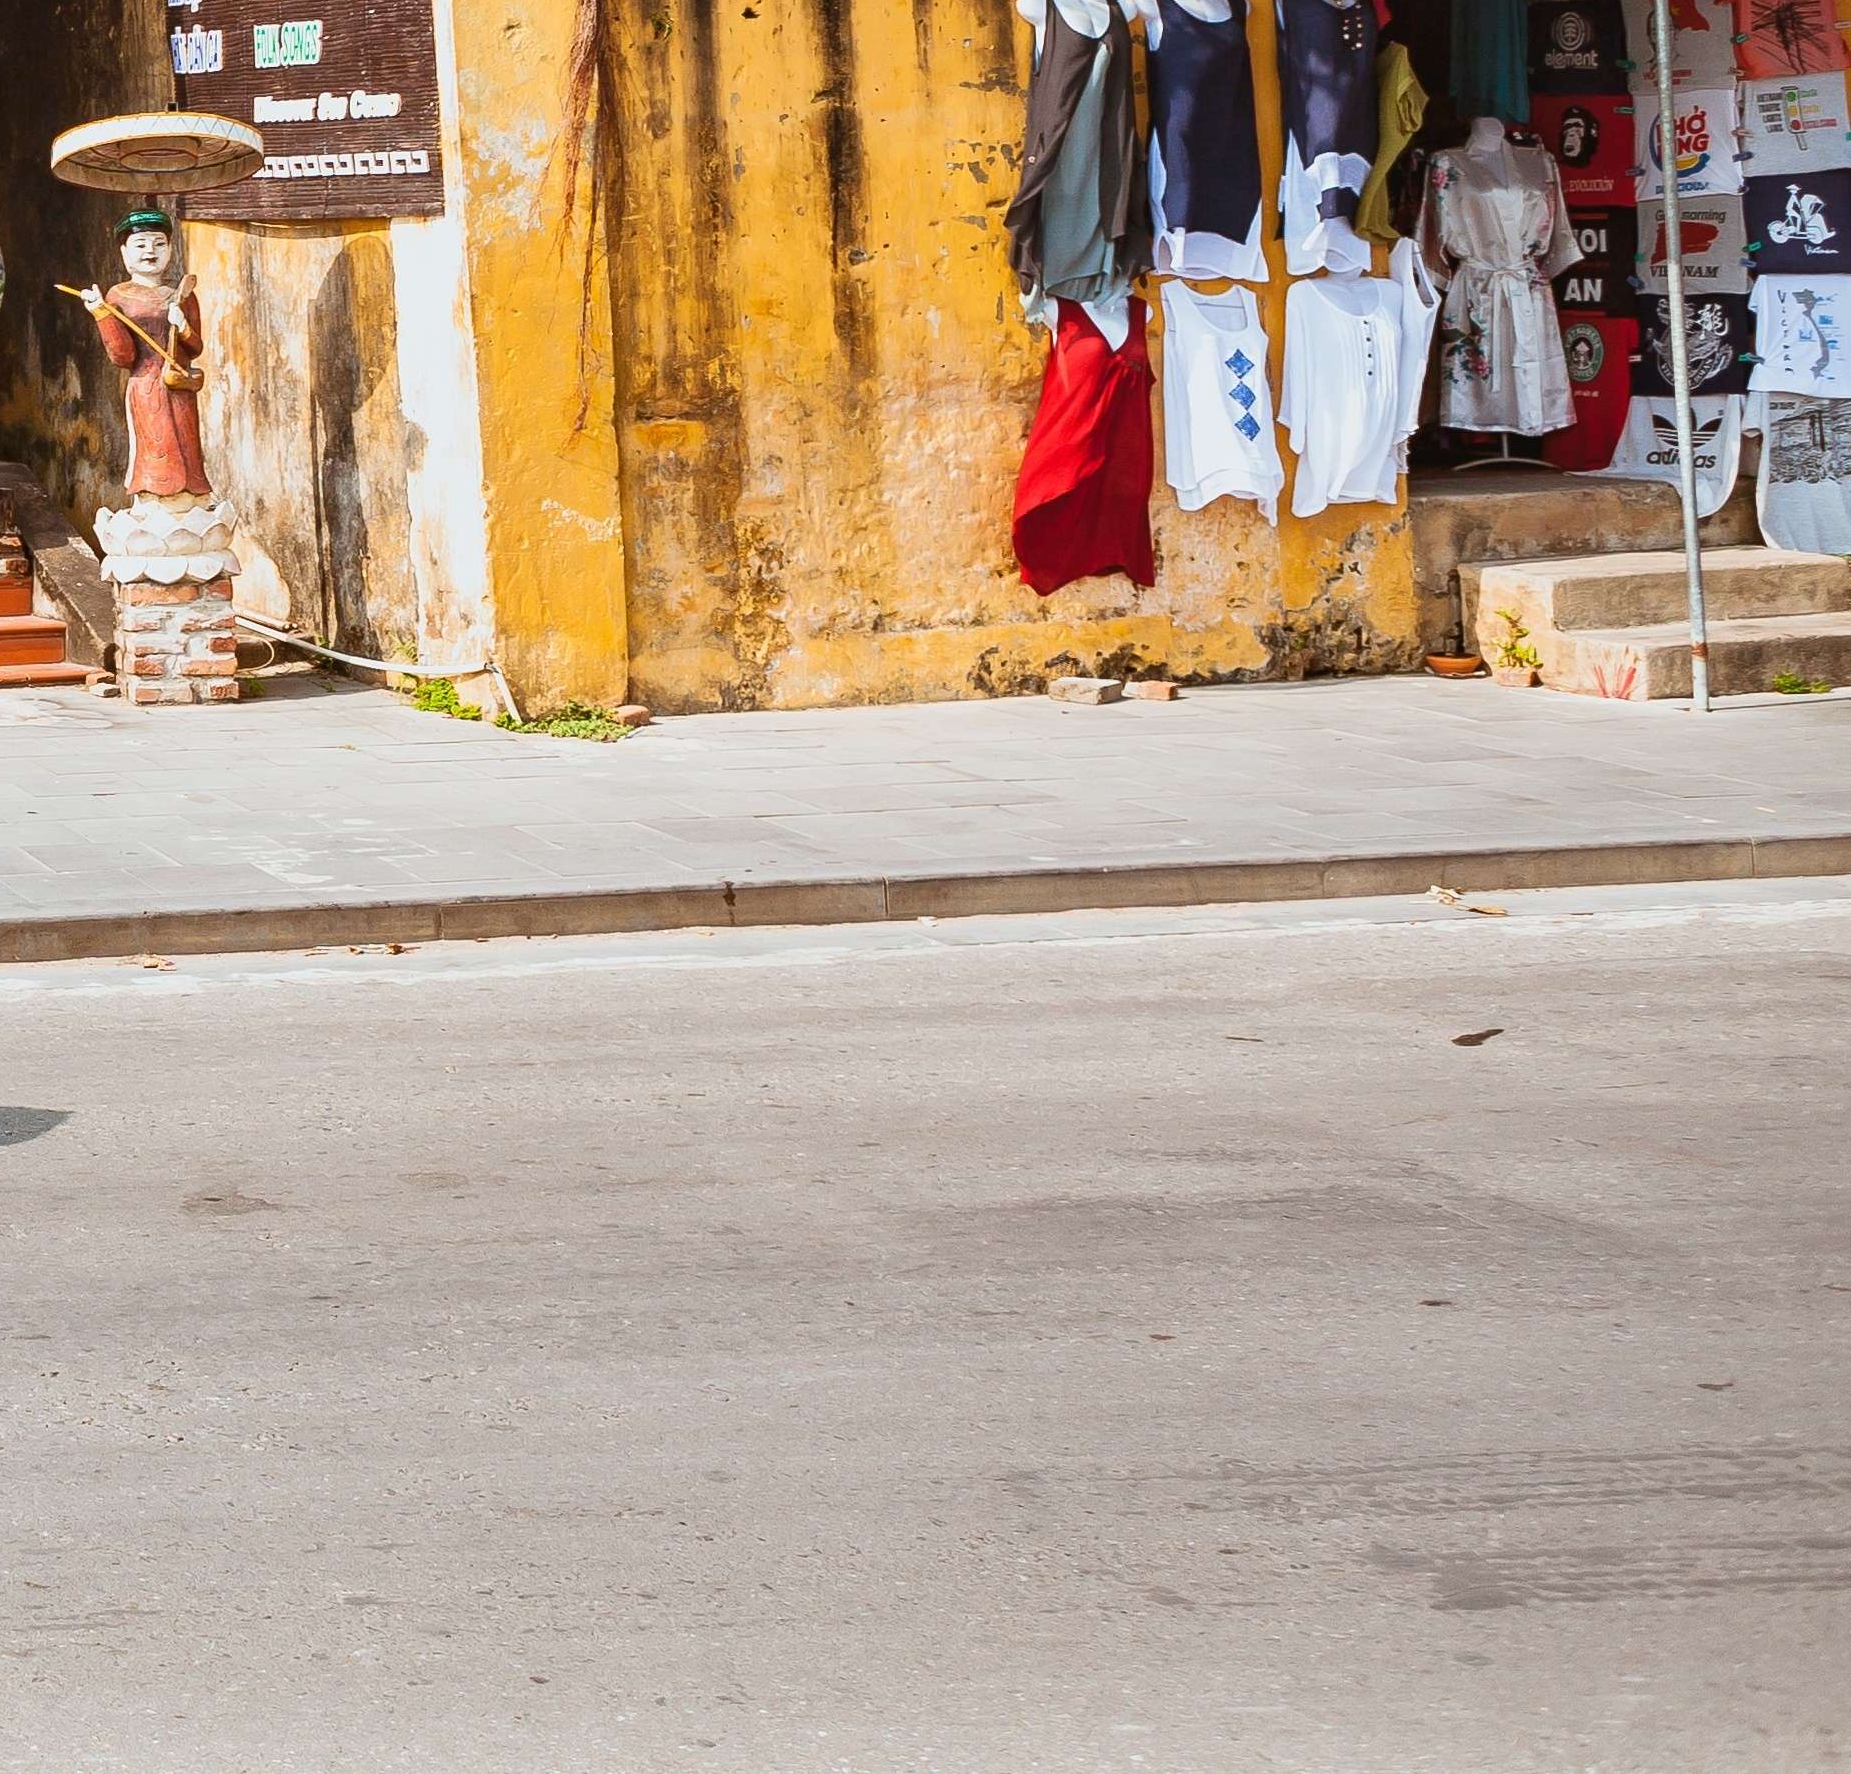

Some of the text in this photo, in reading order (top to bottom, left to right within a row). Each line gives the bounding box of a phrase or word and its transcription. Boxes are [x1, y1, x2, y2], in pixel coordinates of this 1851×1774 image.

[253, 24, 281, 68] FOLK
[281, 19, 323, 66] SONGS
[1545, 49, 1599, 68] element
[1563, 278, 1602, 302] AN
[1646, 448, 1717, 469] adias
